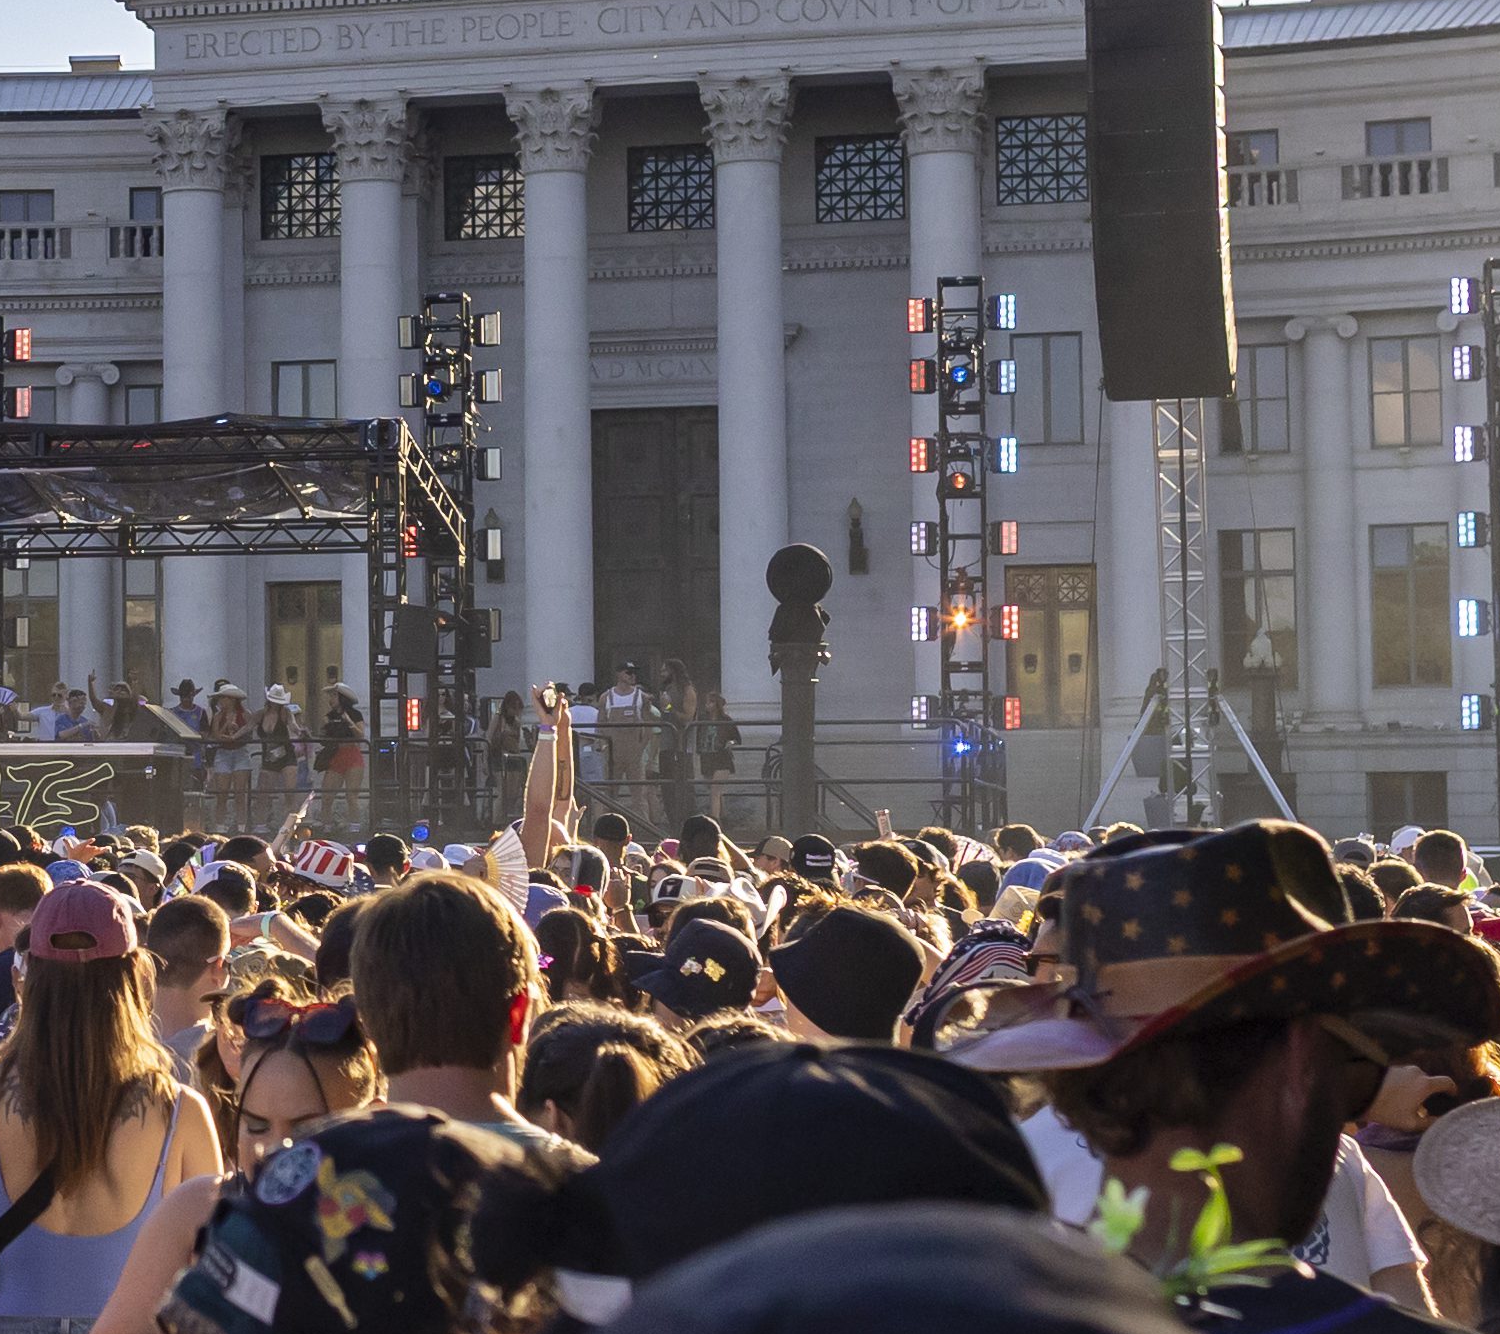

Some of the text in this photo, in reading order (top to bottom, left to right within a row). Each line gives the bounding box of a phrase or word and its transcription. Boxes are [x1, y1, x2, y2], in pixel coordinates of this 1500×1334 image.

[183, 26, 322, 60] ERECTED
[335, 22, 373, 51] BY
[384, 18, 449, 47] THE
[460, 10, 575, 43] PEOPLE
[597, 3, 675, 35] CITY
